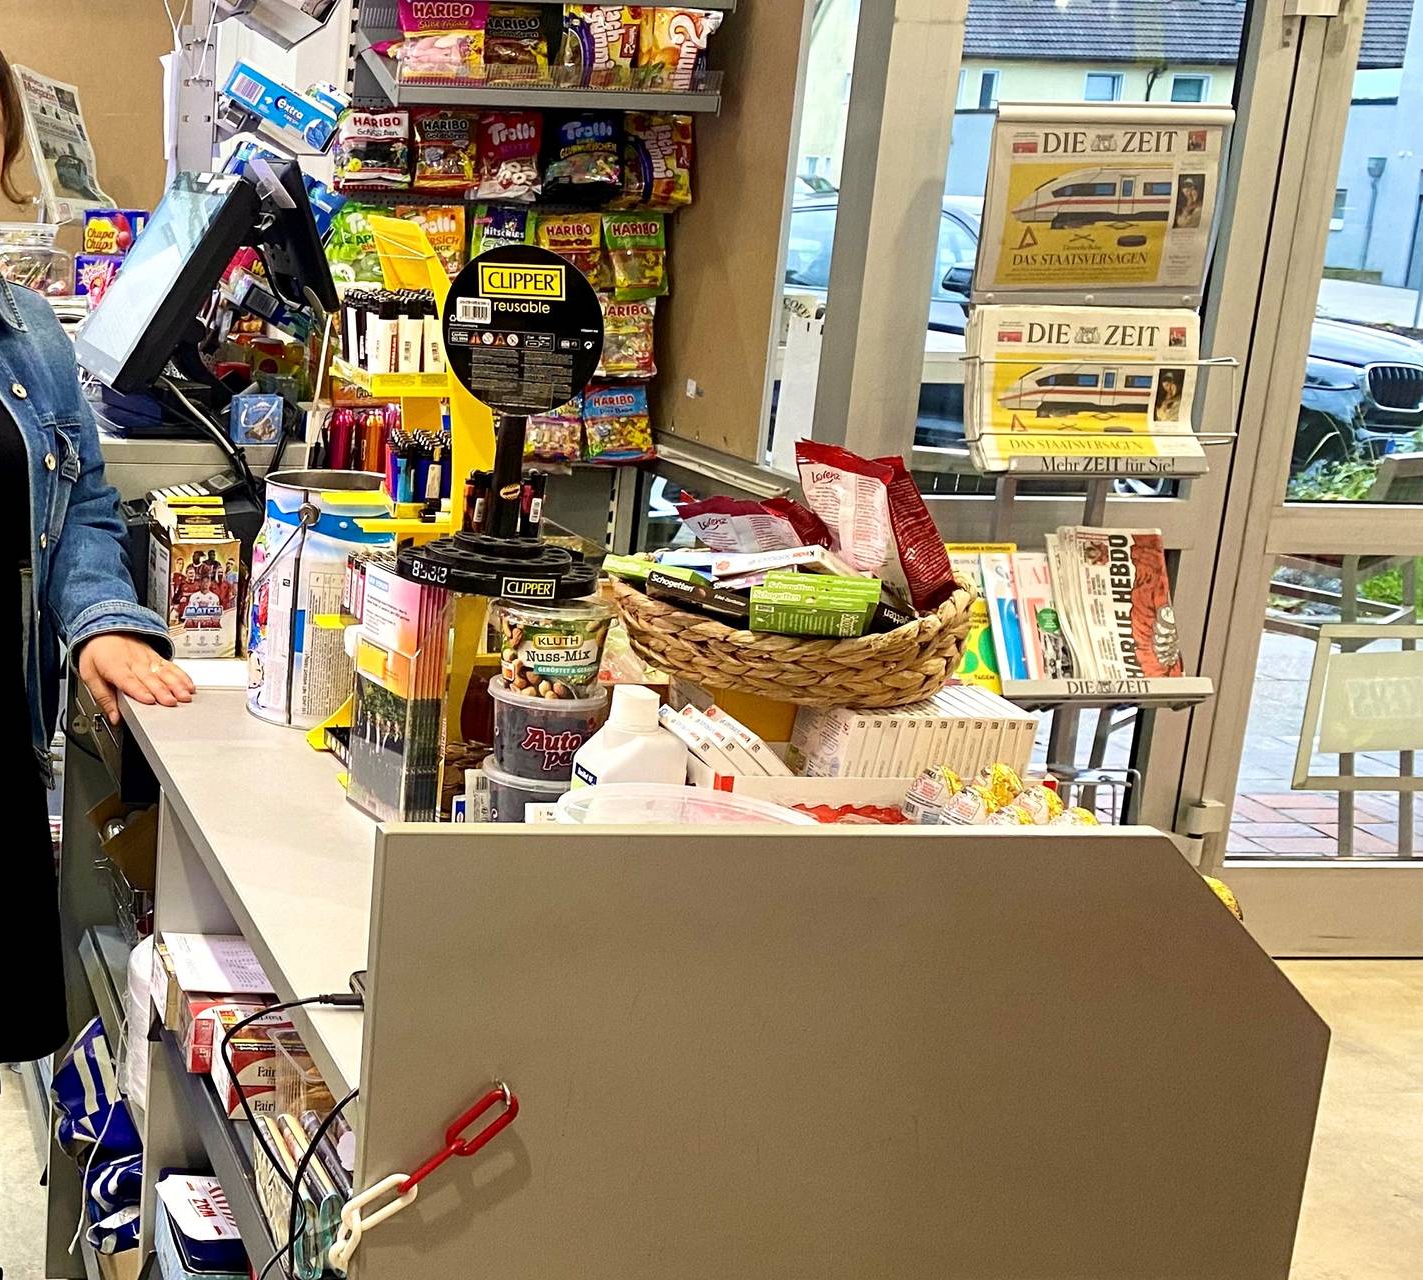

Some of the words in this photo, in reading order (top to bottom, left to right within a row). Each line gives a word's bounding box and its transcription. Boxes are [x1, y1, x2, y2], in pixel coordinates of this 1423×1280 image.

[413, 3, 474, 18] HARIBO
[277, 98, 304, 119] extra
[353, 116, 401, 128] HARIBO
[422, 119, 469, 131] HARIBO
[487, 122, 536, 145] Trolli
[561, 121, 613, 140] Trolli
[1042, 131, 1087, 153] DIE
[1121, 130, 1179, 153] ZEIT
[87, 228, 115, 239] Chupa
[546, 224, 593, 237] HARIBO
[612, 222, 660, 237] HARIBO
[86, 239, 113, 250] Chups
[1012, 253, 1038, 266] DAS
[1040, 252, 1149, 265] STAATSVERSAGEN
[488, 271, 554, 291] CLIPPER
[493, 300, 551, 314] reusable
[1027, 322, 1072, 345] DIE
[1104, 325, 1160, 347] ZEIT
[592, 395, 635, 407] HARIBO
[1040, 456, 1080, 473] Mehr
[1083, 456, 1120, 472] ZEIT
[1124, 456, 1145, 472] für
[1149, 456, 1176, 473] Sie!
[810, 469, 842, 485] Lorenz
[697, 516, 728, 530] Lorenz
[1108, 534, 1133, 603] HEBDO
[507, 581, 552, 595] CLIPPER
[537, 636, 579, 646] KLUTH
[1114, 610, 1146, 678] HARLIE
[526, 649, 592, 664] Nuss-Mix
[1067, 680, 1094, 695] DIE
[1115, 680, 1152, 694] ZEIT
[522, 727, 582, 751] Auto
[257, 1066, 275, 1077] Fair
[254, 1100, 275, 1112] Fair
[192, 1198, 217, 1217] WAZ
